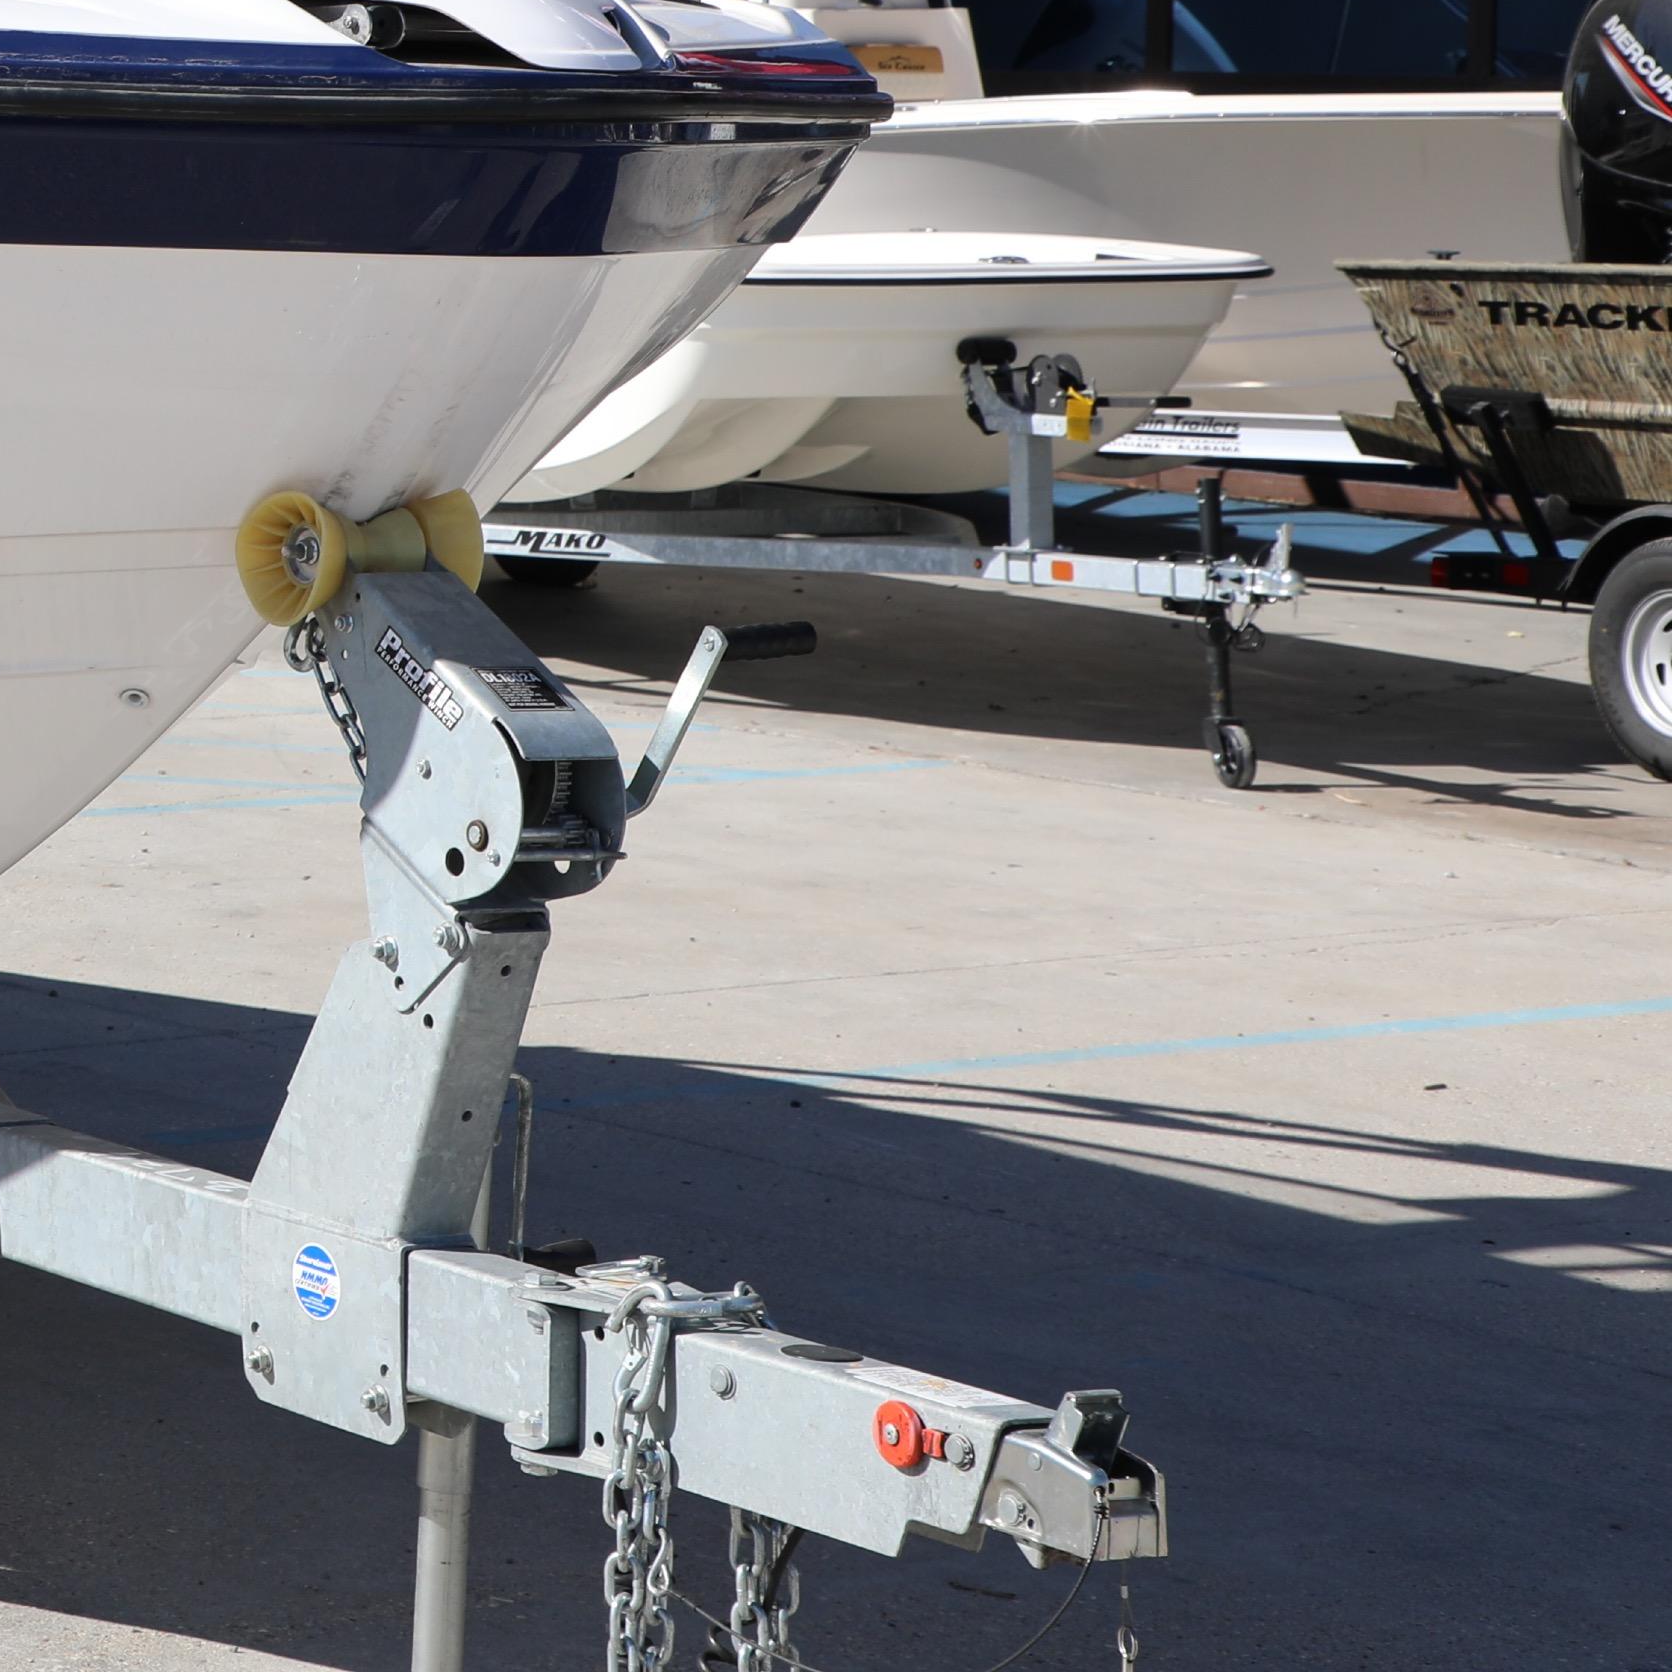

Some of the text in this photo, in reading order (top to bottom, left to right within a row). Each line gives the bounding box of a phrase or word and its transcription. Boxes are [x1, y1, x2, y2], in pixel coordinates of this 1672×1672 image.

[1478, 300, 1672, 331] TRACK
[1172, 415, 1241, 432] Trailers
[506, 531, 608, 554] MAKO
[376, 646, 457, 730] PERFORMANCE WINCH
[379, 627, 464, 721] Profile
